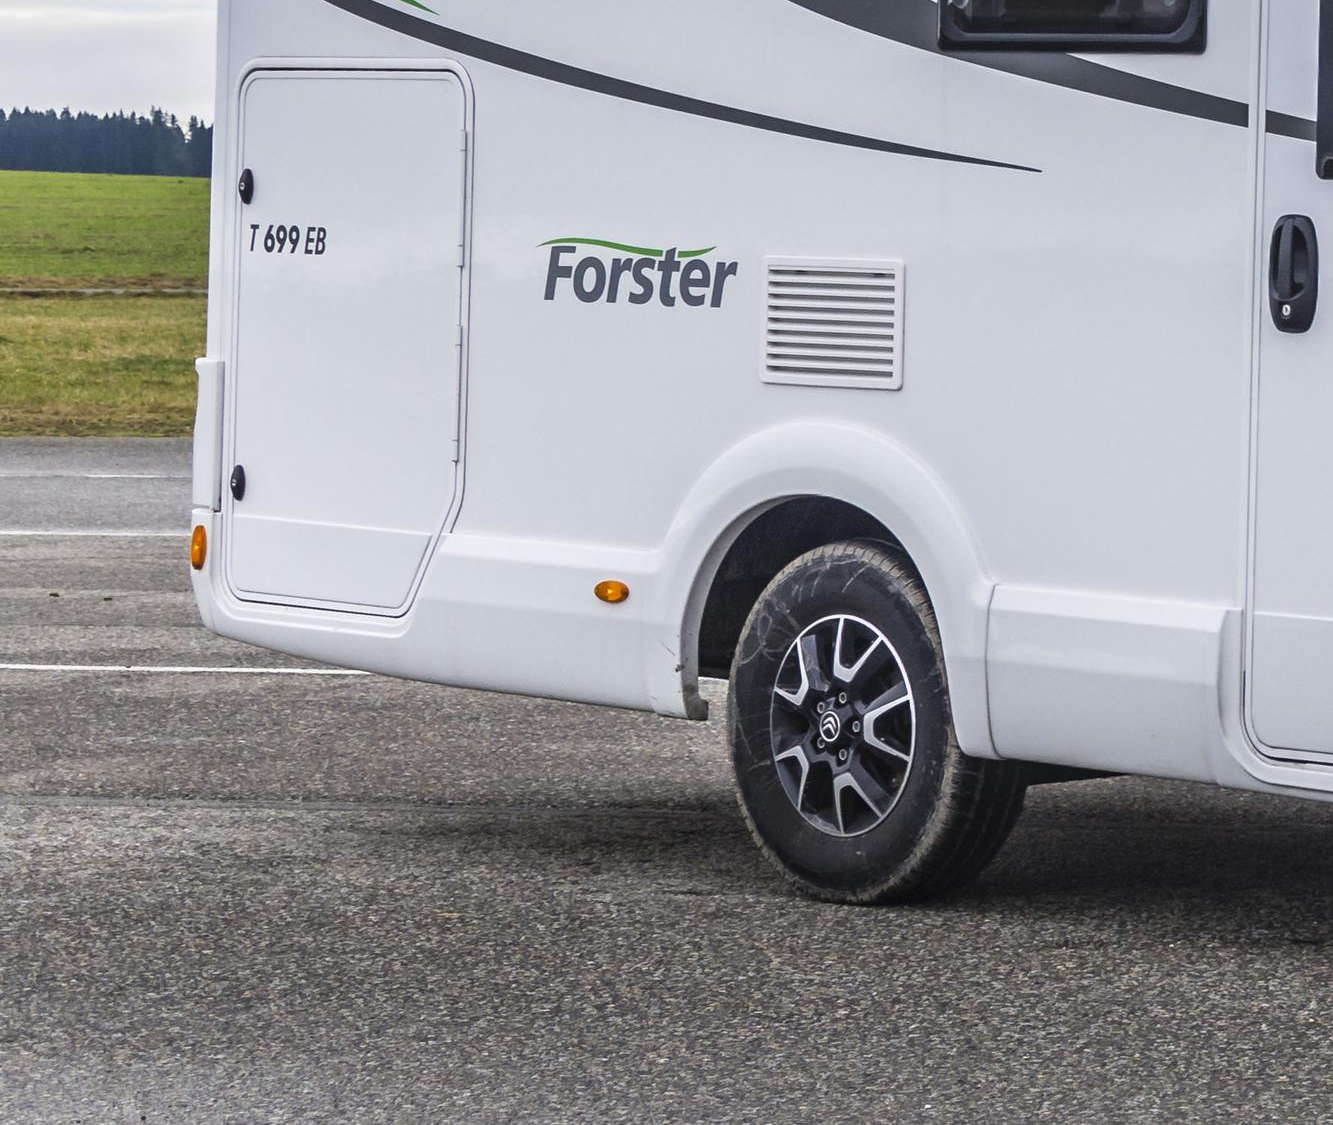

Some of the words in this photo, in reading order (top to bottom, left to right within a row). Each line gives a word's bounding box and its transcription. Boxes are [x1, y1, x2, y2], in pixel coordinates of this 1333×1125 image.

[250, 224, 260, 252] T
[263, 224, 300, 254] 699
[304, 227, 327, 255] EB
[543, 245, 738, 308] Forster
